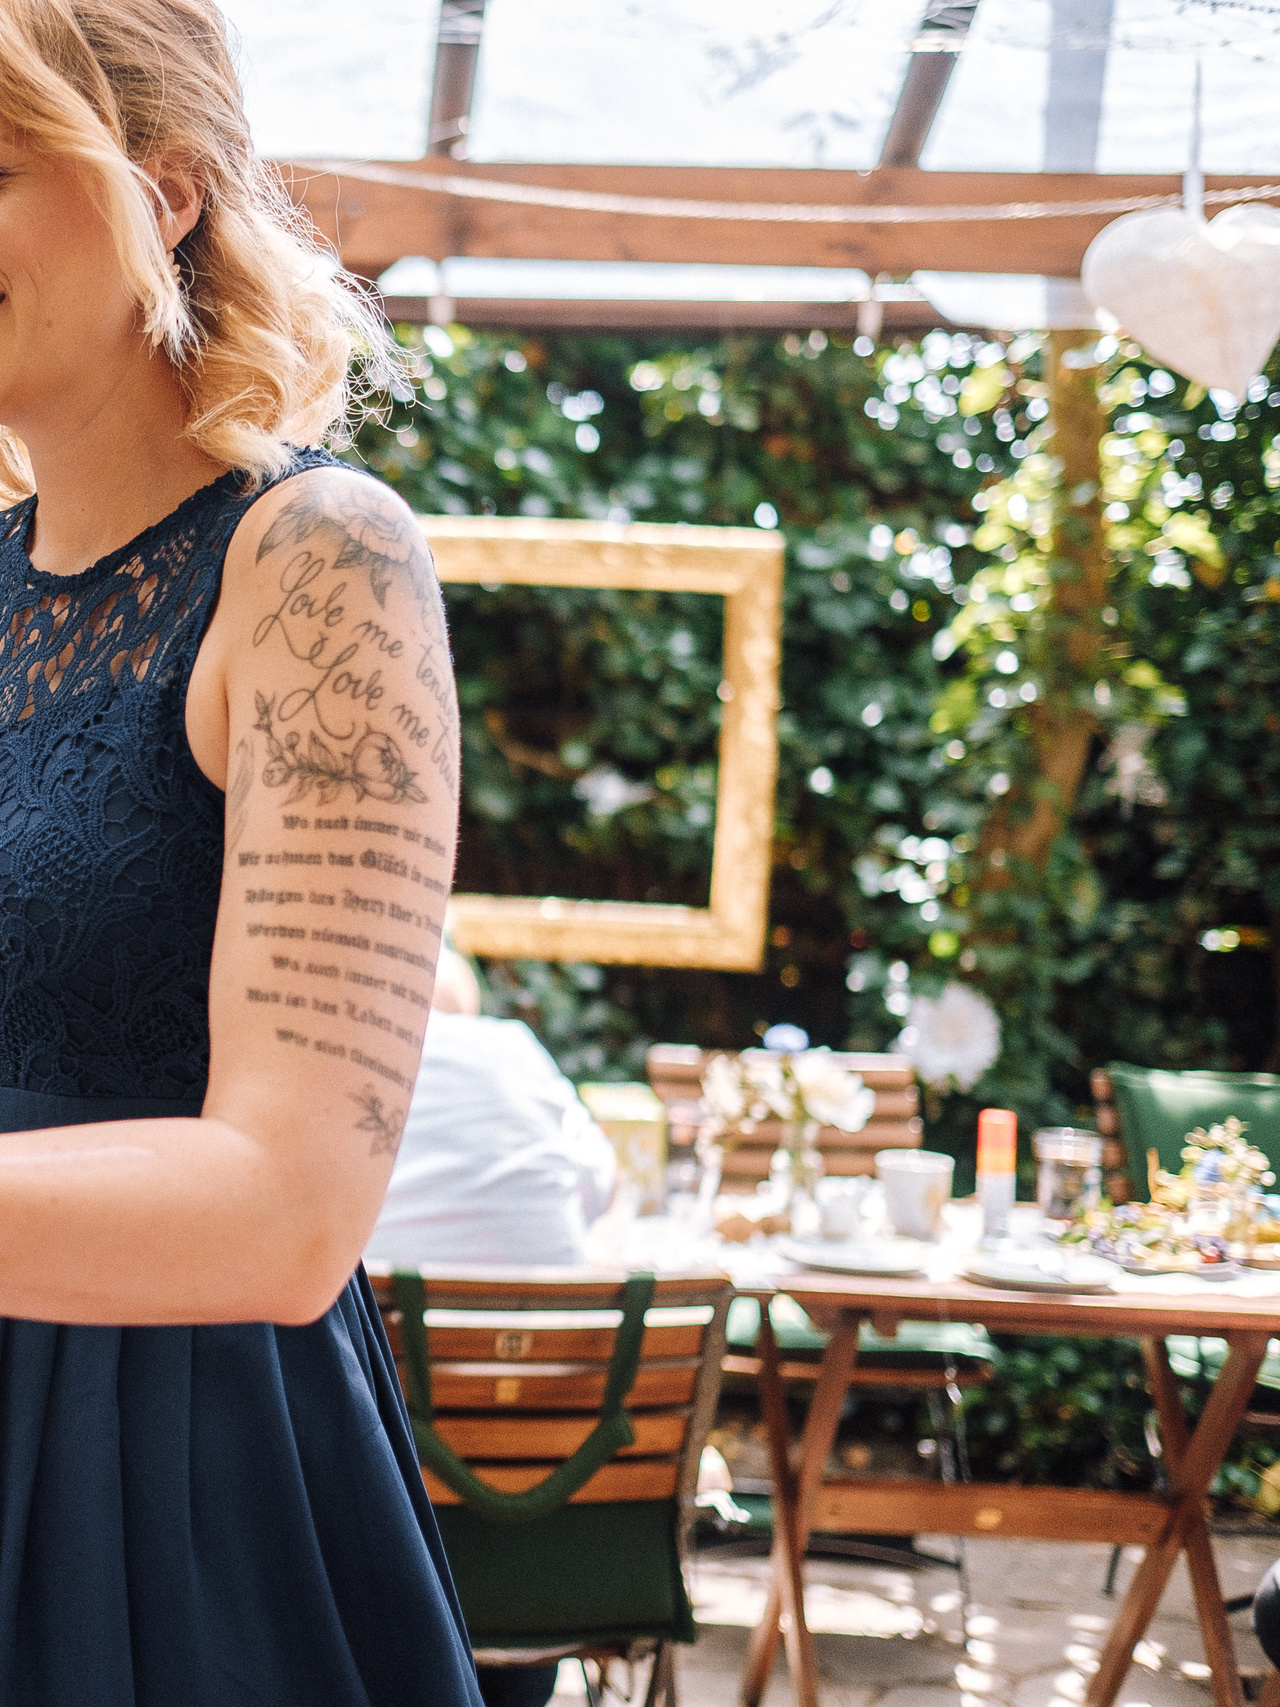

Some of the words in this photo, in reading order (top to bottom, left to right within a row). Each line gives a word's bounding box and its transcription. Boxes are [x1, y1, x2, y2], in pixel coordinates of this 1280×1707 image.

[253, 551, 347, 658] Love
[351, 619, 404, 659] me
[278, 632, 384, 740] Love
[391, 703, 430, 748] me
